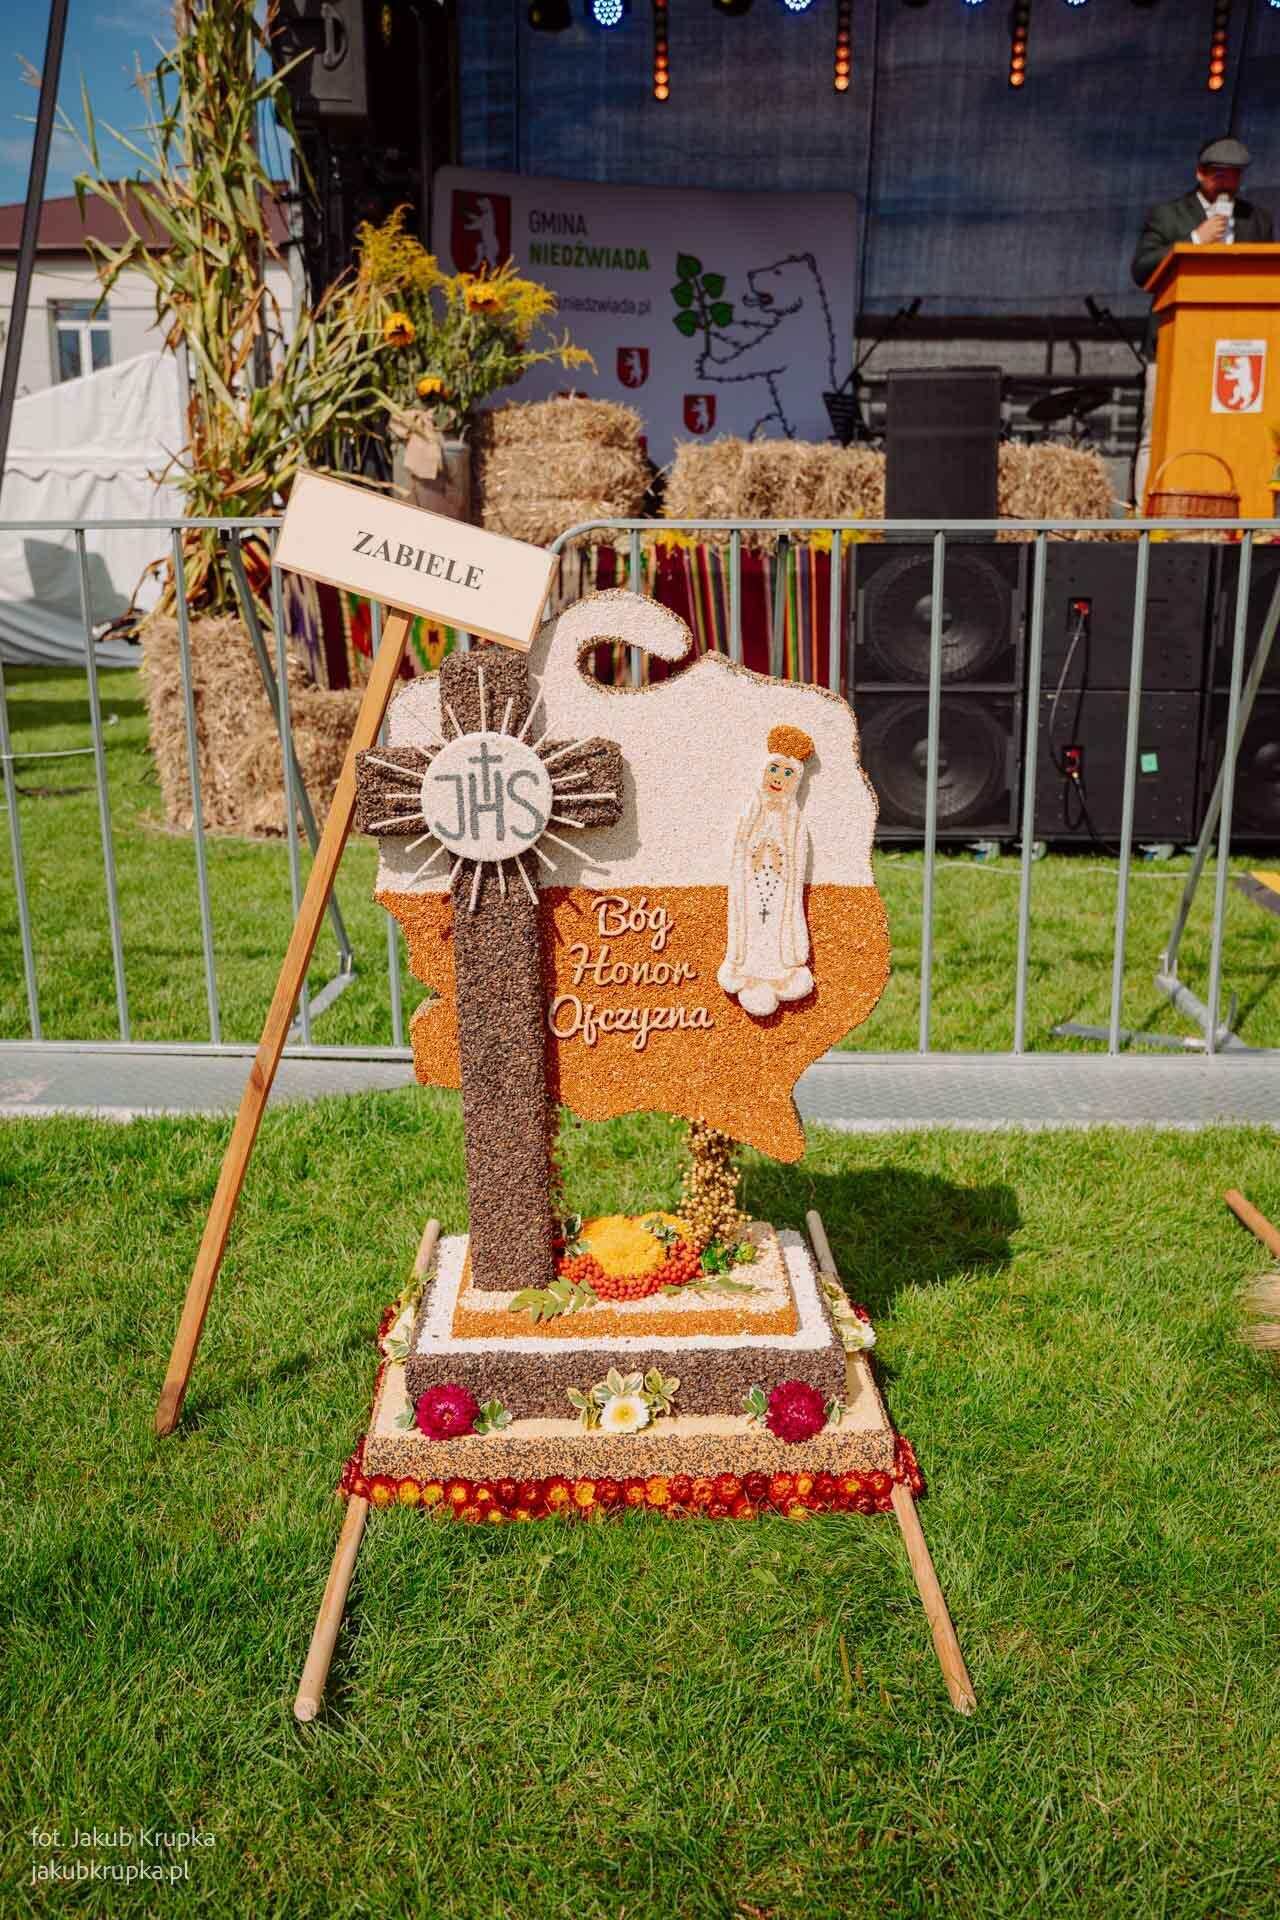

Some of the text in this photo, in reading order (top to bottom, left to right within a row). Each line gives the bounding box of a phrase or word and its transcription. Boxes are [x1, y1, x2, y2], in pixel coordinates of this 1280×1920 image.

[528, 209, 587, 236] GMINA
[528, 240, 649, 271] NIEDŹWIADA
[555, 293, 651, 316] niedzwiada.pl
[352, 529, 485, 590] ZABIELE
[591, 895, 675, 950] Bóg
[569, 942, 697, 986] Honor
[549, 993, 714, 1050] Ojczyzna
